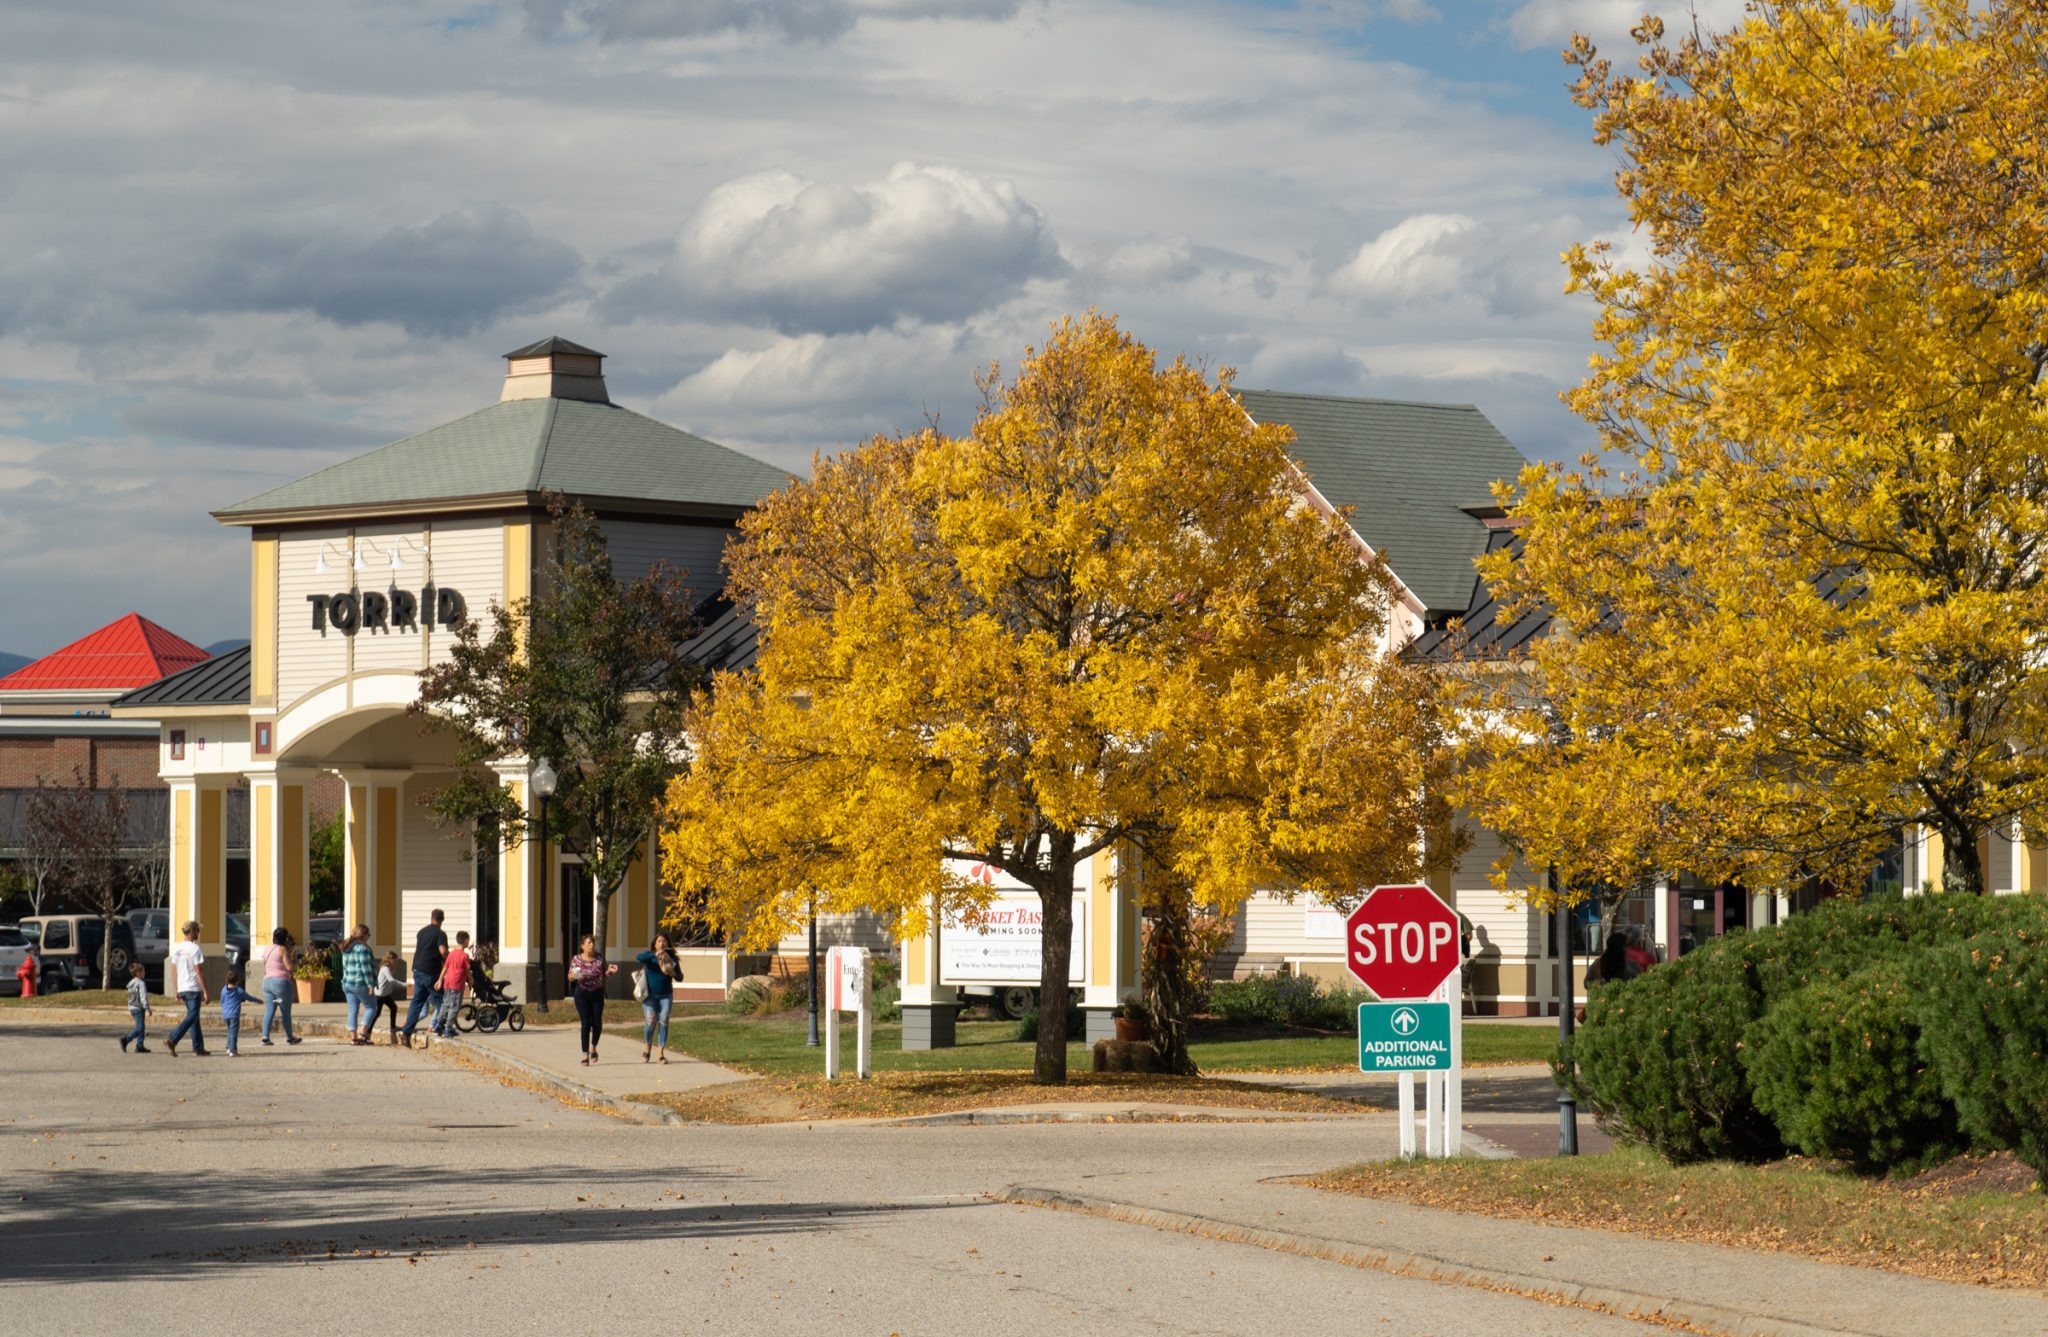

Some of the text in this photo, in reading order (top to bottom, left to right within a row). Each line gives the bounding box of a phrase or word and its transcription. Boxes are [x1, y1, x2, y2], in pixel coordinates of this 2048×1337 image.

[306, 587, 463, 630] TORRID
[1016, 908, 1042, 925] BAS
[1354, 921, 1452, 965] STOP
[843, 964, 859, 975] Ente
[1365, 1040, 1447, 1053] ADDITIONAL
[1376, 1055, 1436, 1067] PARKING
